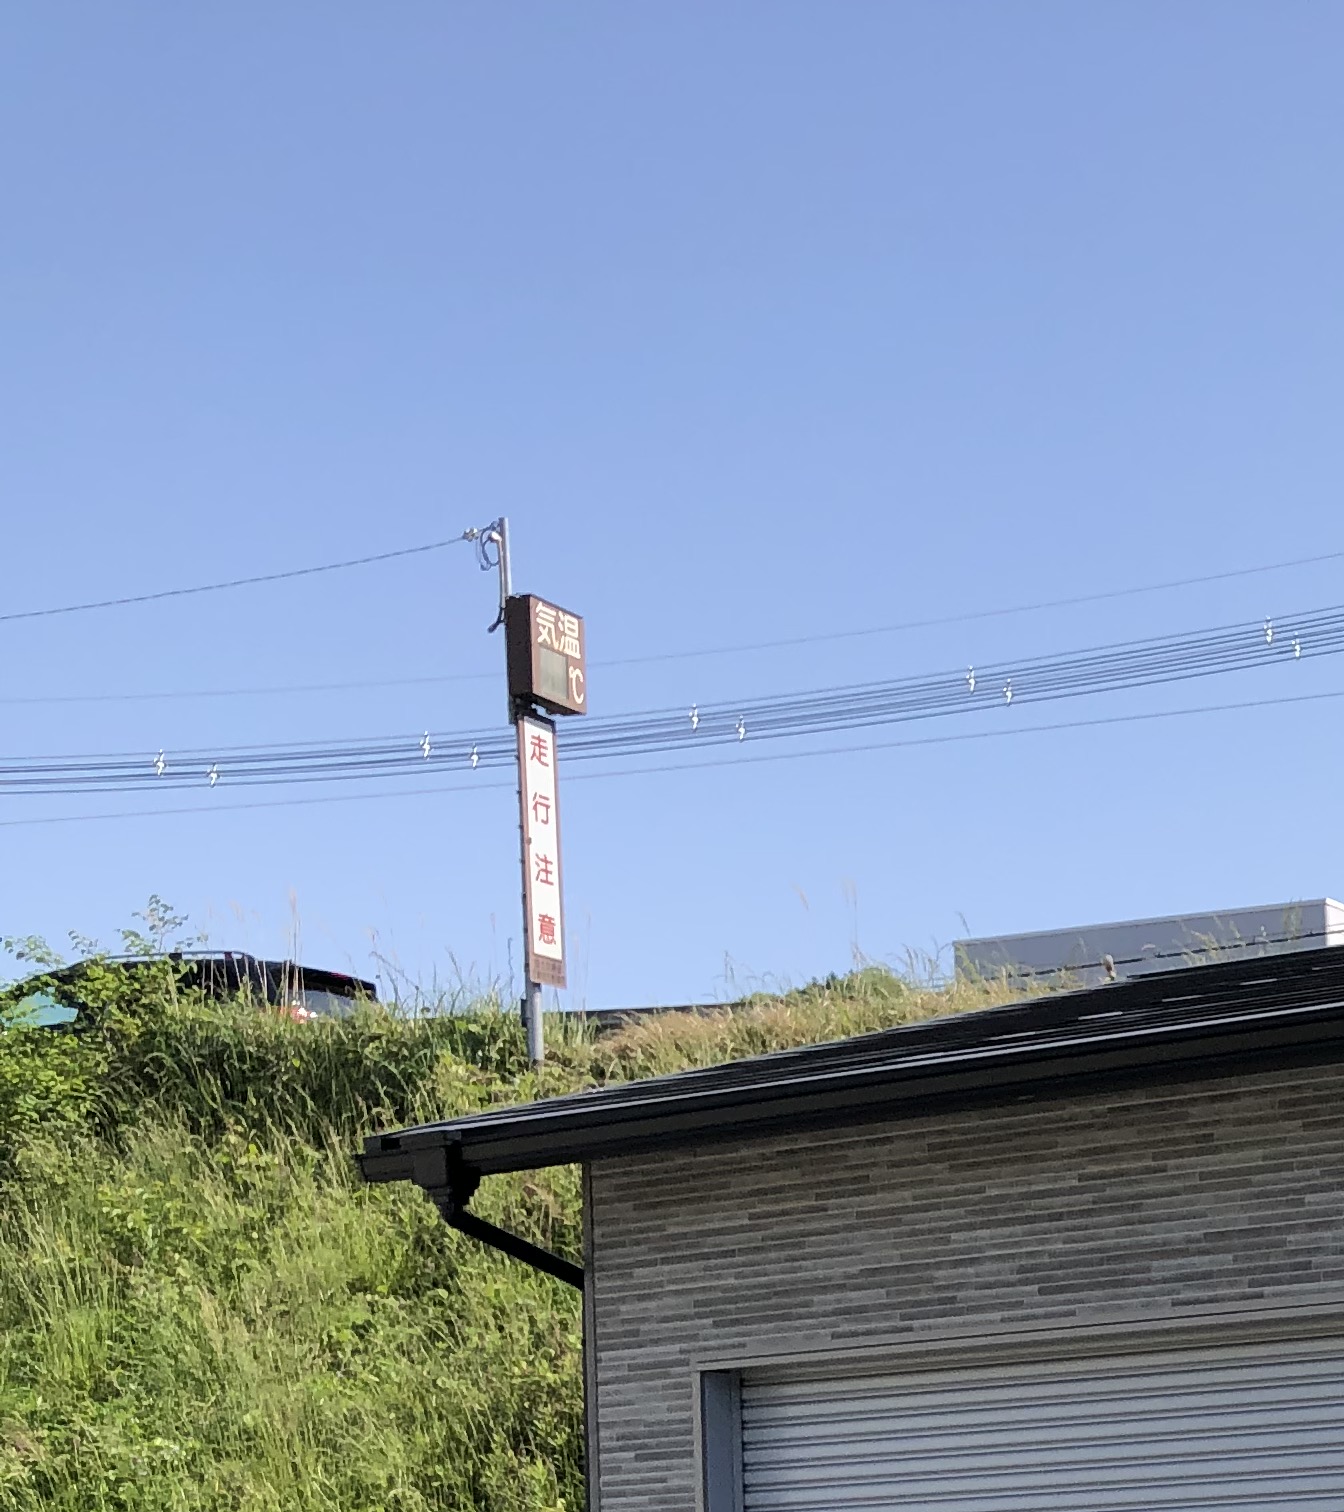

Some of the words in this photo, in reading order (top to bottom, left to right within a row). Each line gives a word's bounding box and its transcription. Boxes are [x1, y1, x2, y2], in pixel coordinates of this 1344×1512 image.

[536, 601, 581, 660] 気温
[530, 734, 557, 946] 走行注意
